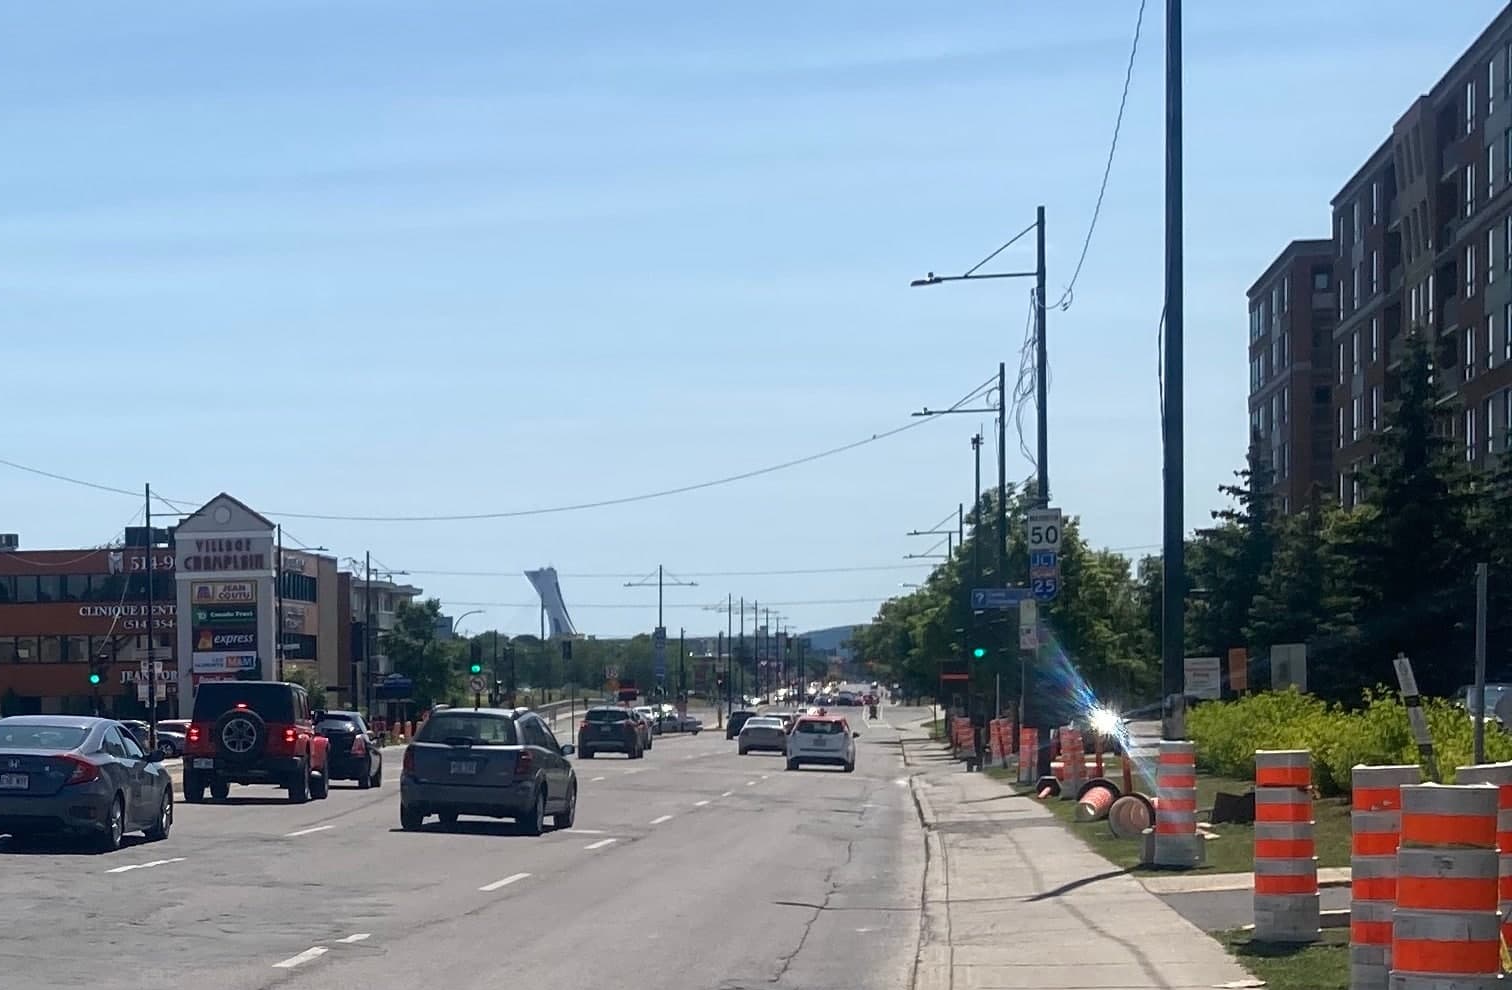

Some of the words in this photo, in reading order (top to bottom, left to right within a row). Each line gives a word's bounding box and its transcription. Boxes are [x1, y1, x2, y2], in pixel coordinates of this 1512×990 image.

[1031, 526, 1058, 544] 50
[130, 555, 176, 570] 514-9
[1034, 580, 1055, 593] 25
[79, 605, 137, 618] CLINIQUE
[141, 605, 177, 616] DENT
[214, 633, 254, 645] express
